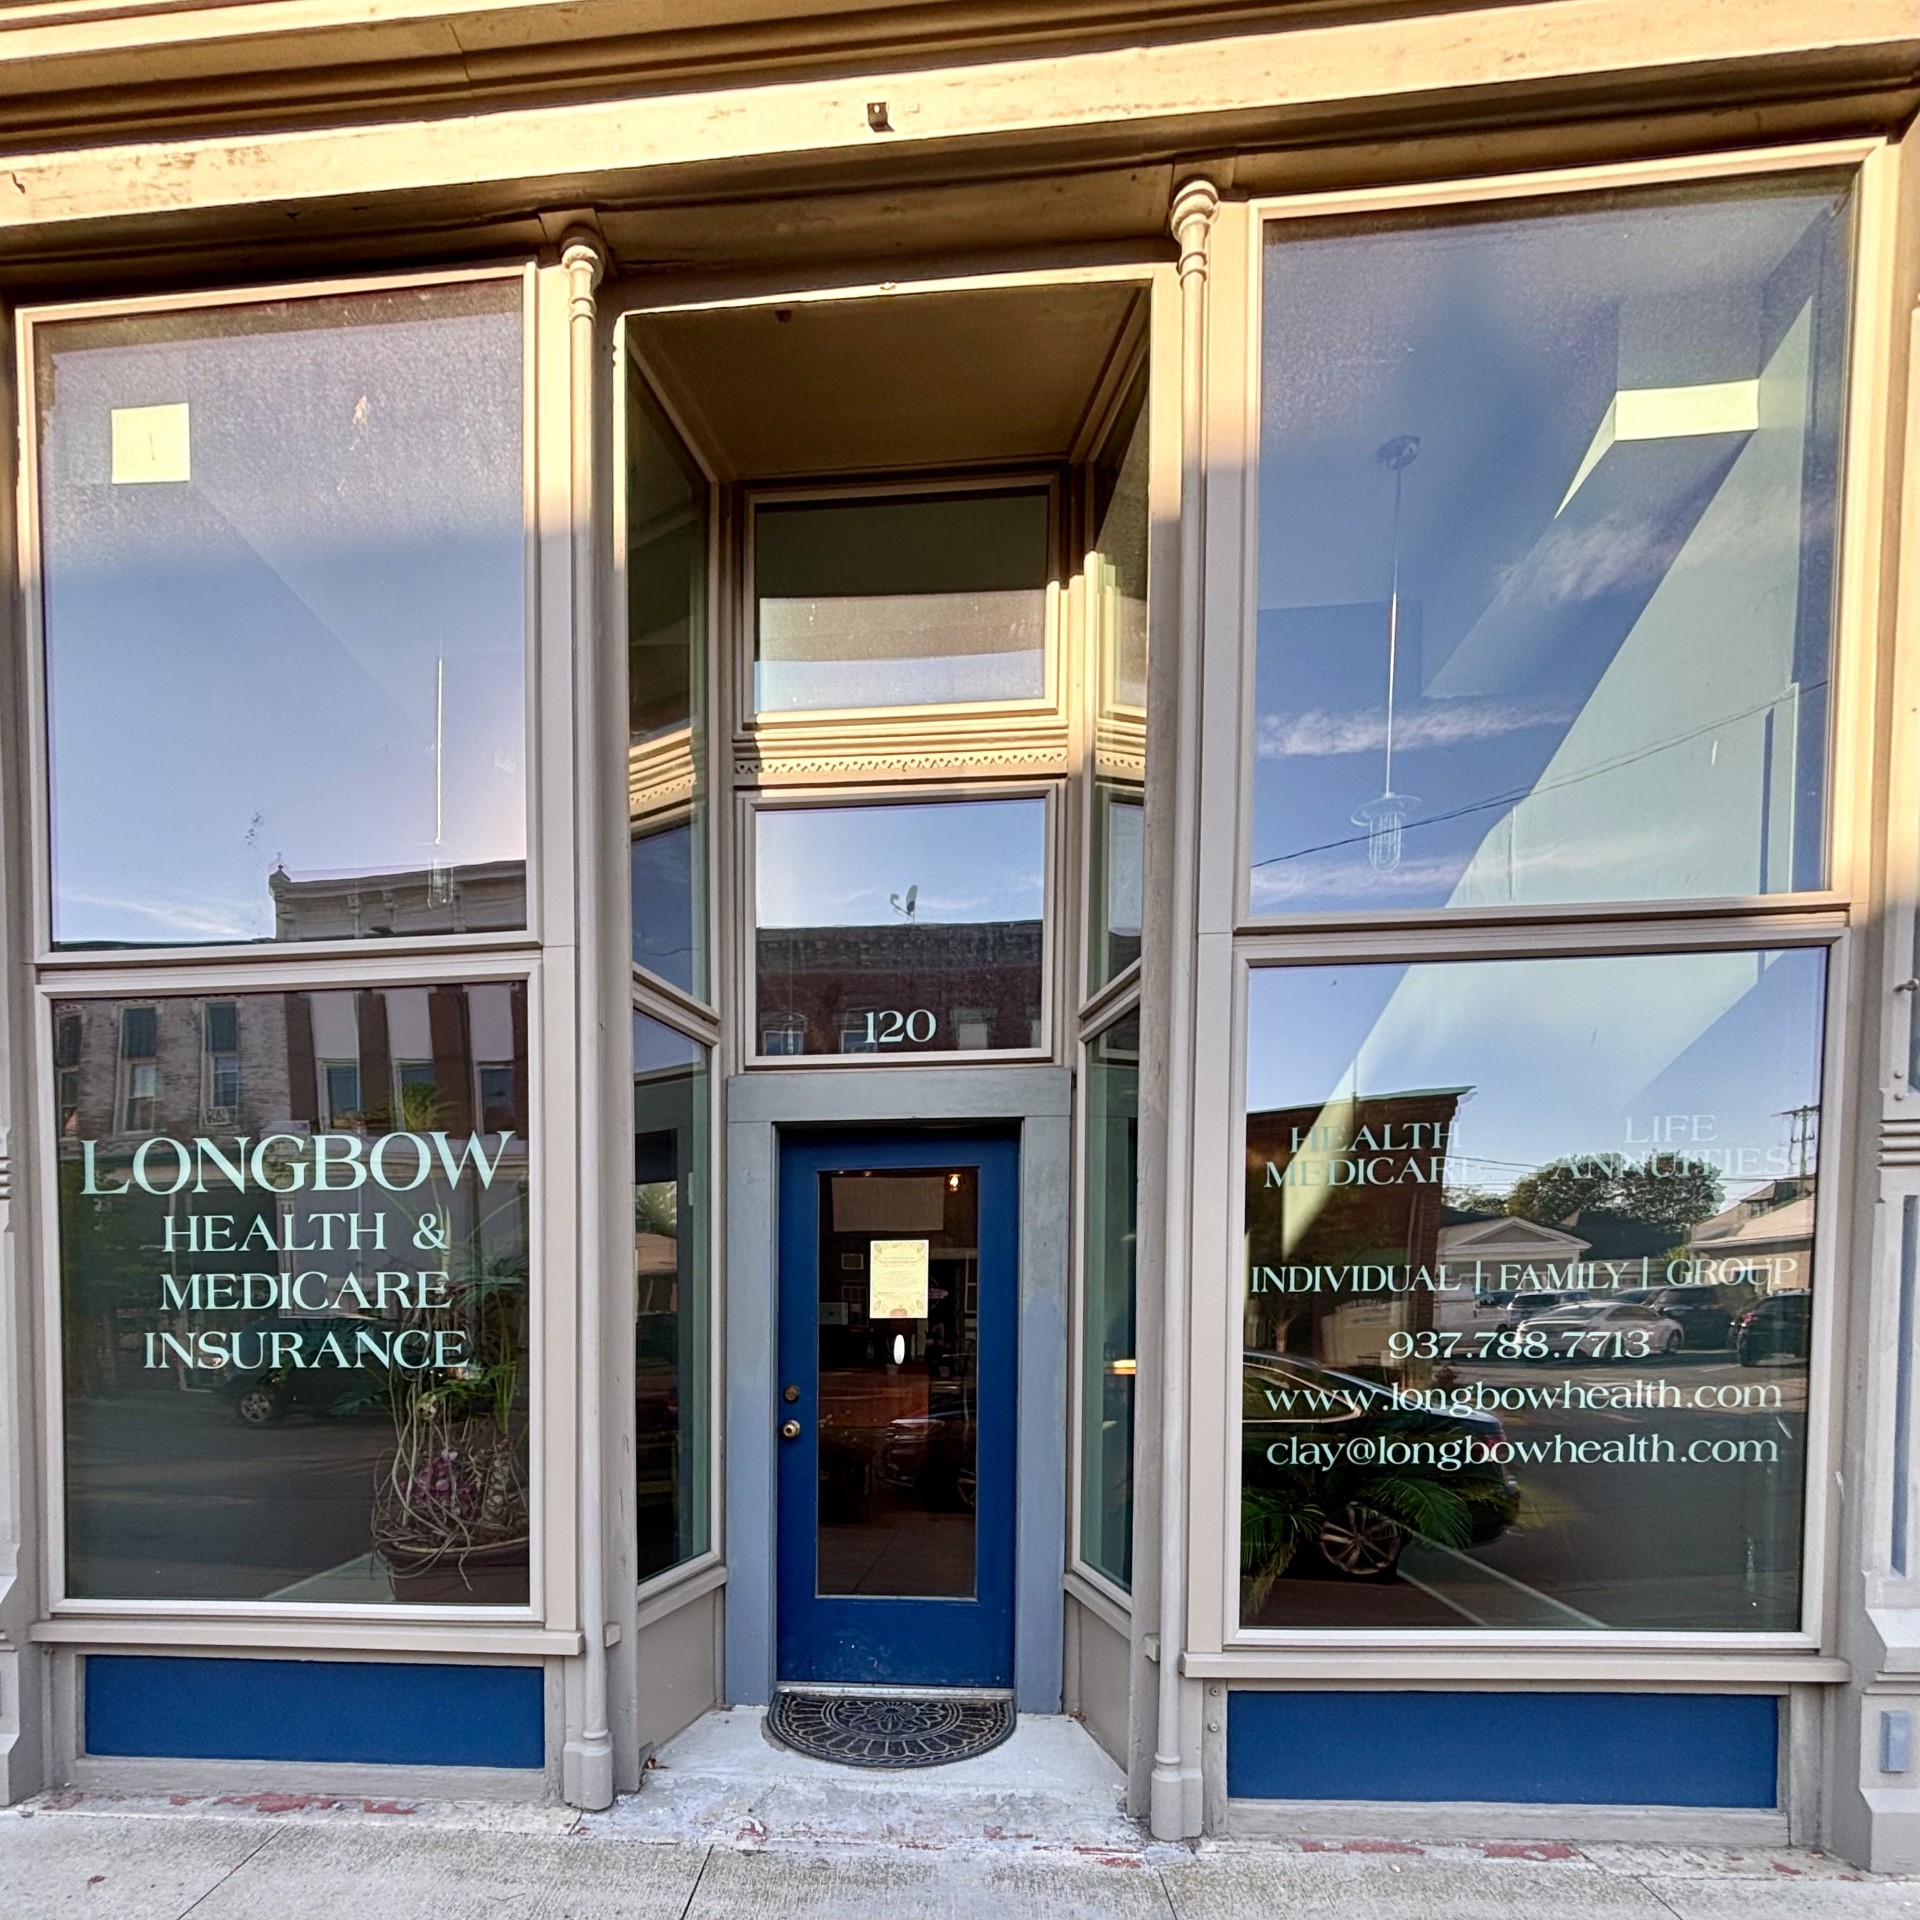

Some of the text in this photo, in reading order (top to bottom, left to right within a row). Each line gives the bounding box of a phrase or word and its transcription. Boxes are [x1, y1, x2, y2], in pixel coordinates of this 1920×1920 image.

[864, 1009, 937, 1043] 120
[1290, 1121, 1462, 1153] HEALTH
[1622, 1114, 1718, 1144] LIFE
[80, 1131, 516, 1195] LONGBOW
[1263, 1155, 1488, 1188] MEDICARE
[1552, 1146, 1790, 1180] ANNUITIES
[162, 1212, 450, 1252] HEALTH &
[159, 1271, 452, 1311] MEDICARE
[1250, 1263, 1462, 1293] INDIVIDUAL
[1500, 1262, 1631, 1292] FAMILY
[1666, 1257, 1798, 1286] GROUP
[143, 1330, 470, 1370] INSURANCE
[1387, 1329, 1651, 1360] 937.788.7713
[1264, 1379, 1783, 1418] www.longbowhealth.com
[1266, 1432, 1779, 1471] clay@longbowhealth.com
